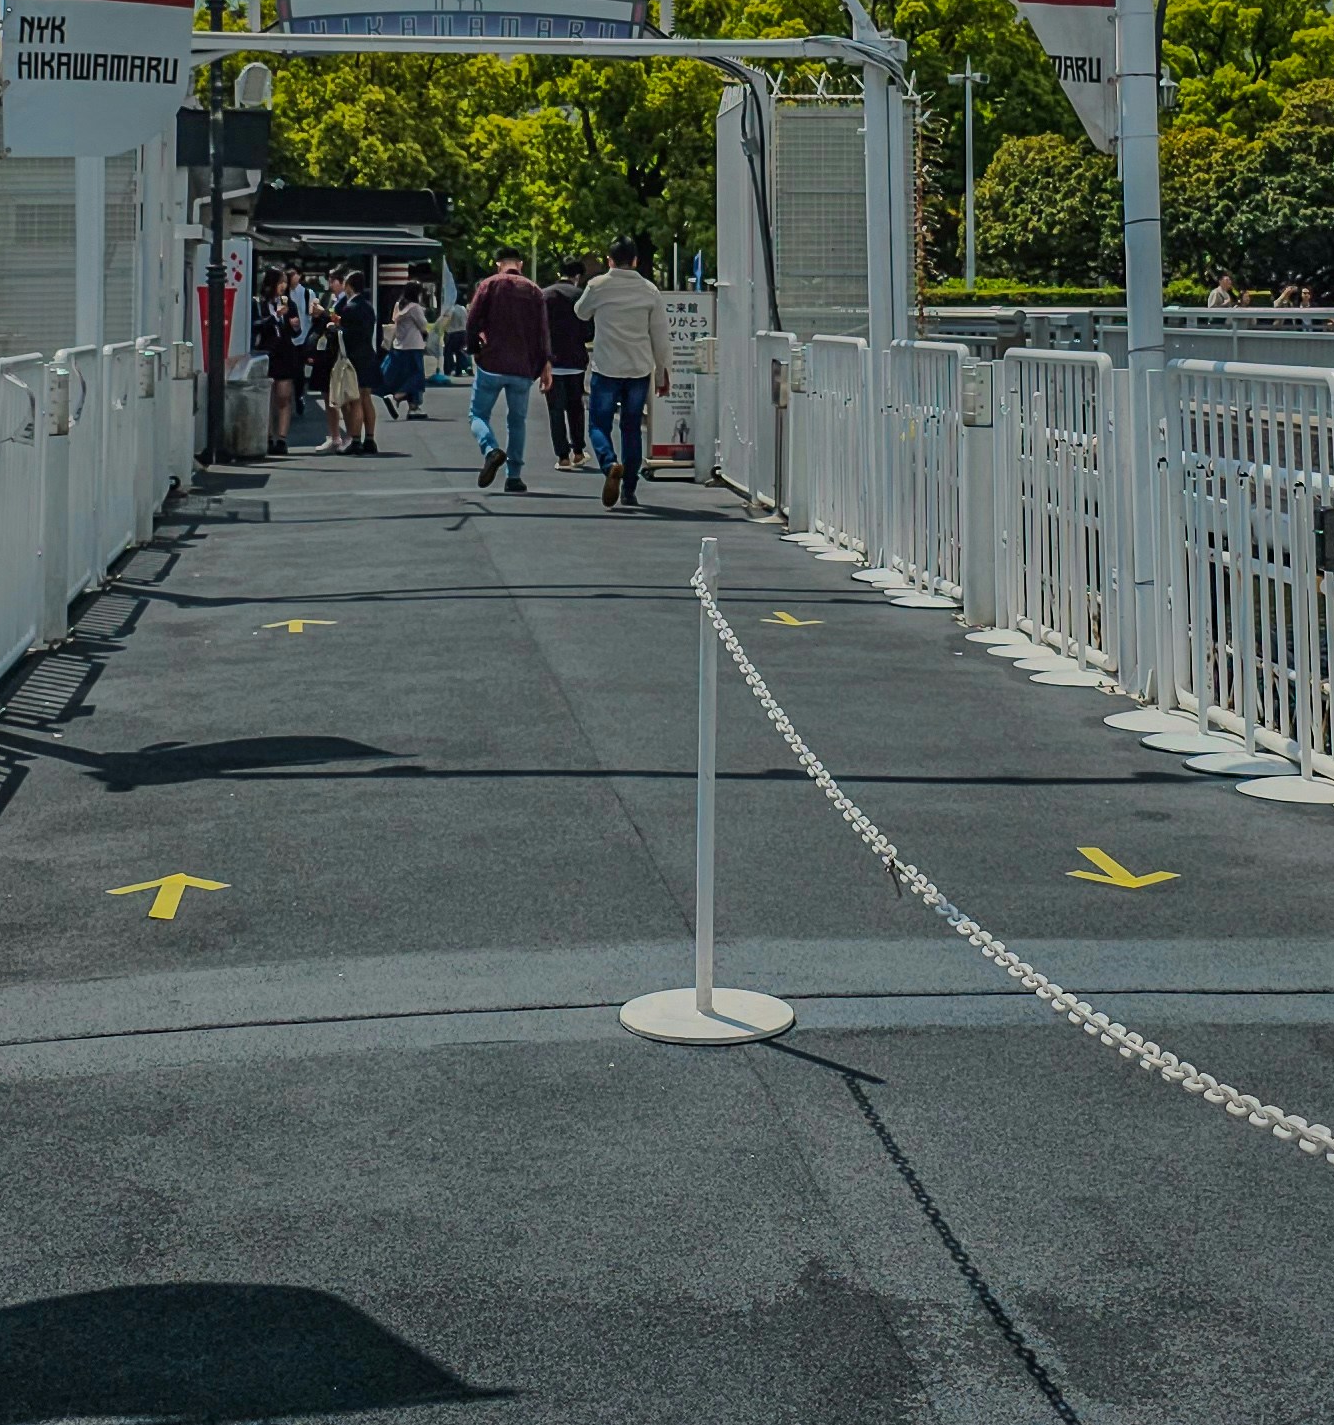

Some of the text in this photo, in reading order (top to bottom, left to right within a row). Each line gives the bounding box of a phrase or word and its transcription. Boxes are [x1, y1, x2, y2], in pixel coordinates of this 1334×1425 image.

[19, 16, 65, 44] NYK
[18, 51, 179, 84] HIKAWAMARU
[668, 317, 708, 328] りがとう
